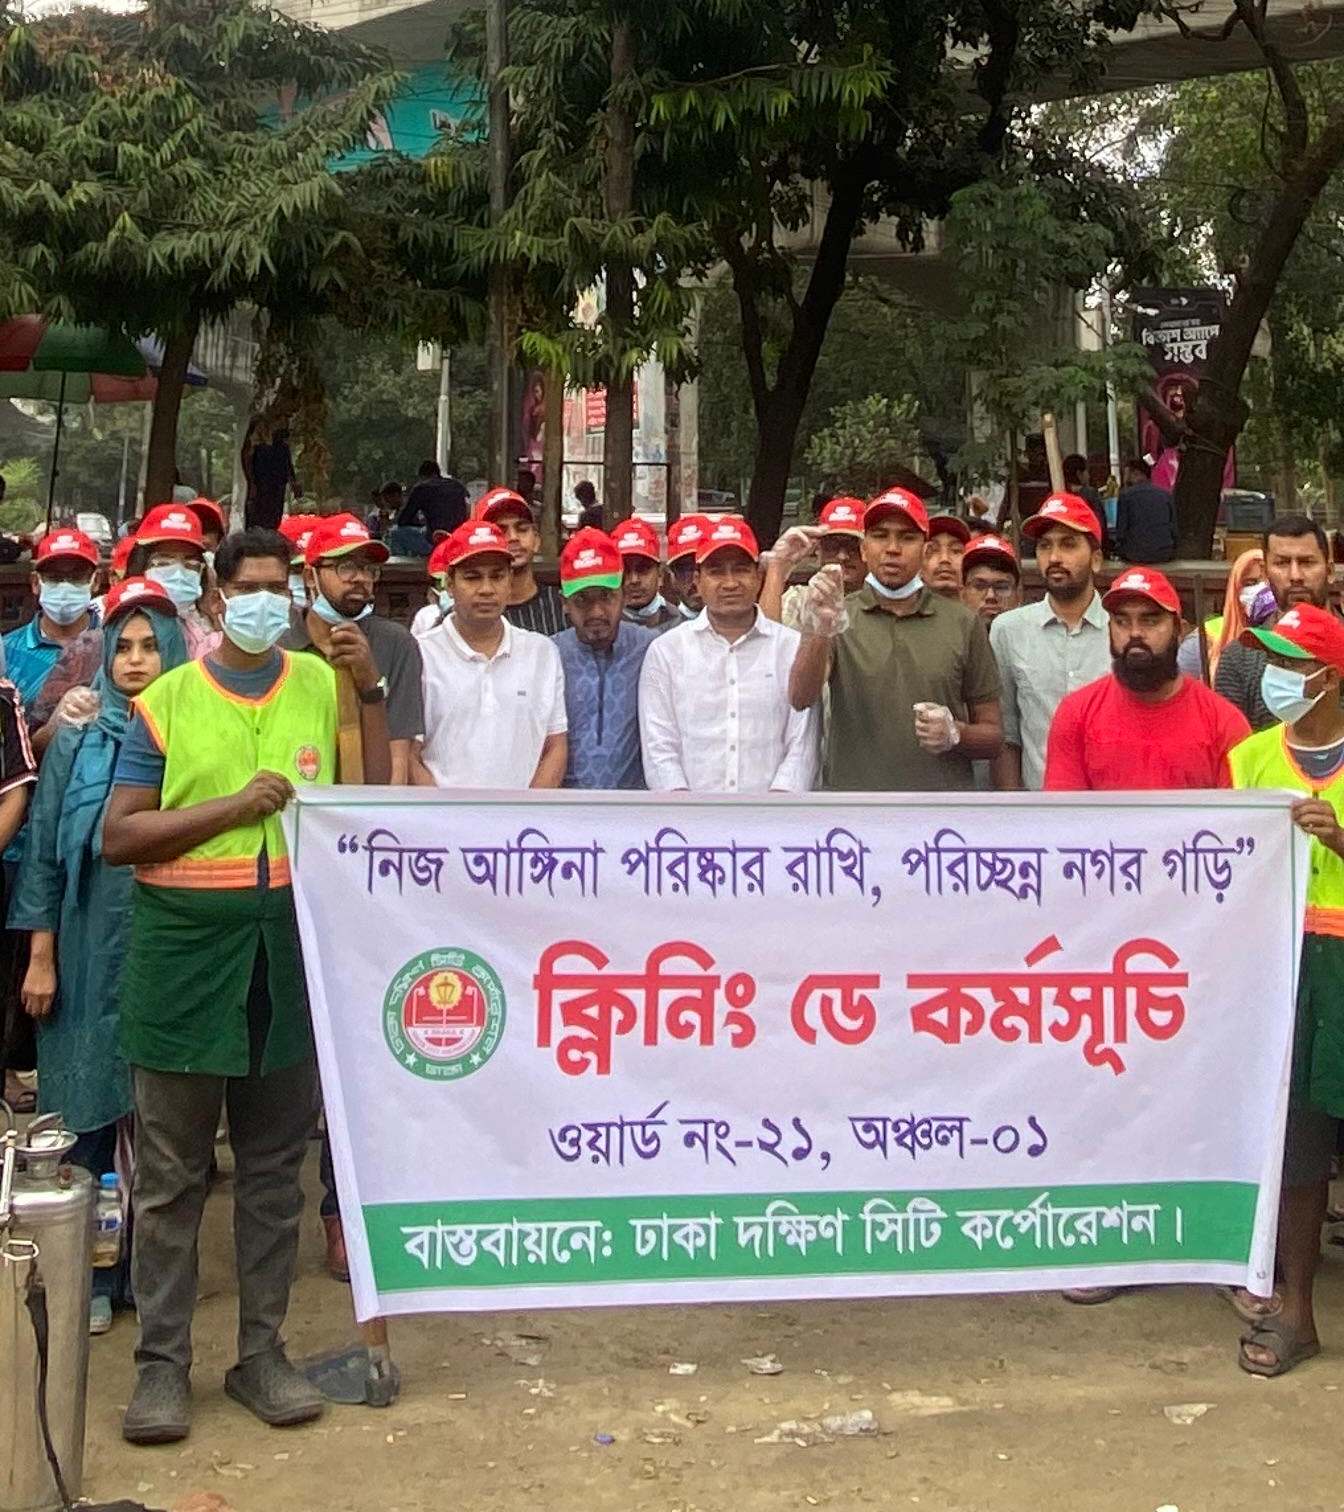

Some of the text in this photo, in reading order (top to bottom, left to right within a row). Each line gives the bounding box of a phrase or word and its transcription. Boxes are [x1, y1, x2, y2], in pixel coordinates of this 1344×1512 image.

[337, 826, 1255, 907] “নিজ আঙ্গিনা পরিষ্কার রাখি, পরিচ্ছন্ন নগর গড়ি”
[533, 934, 1189, 1076] ক্লিনিং ডে কর্মসূচি
[549, 1101, 1049, 1170] ওয়ার্ড নং-২১, অঞ্চল-০১
[628, 1210, 724, 1261] ঢাকা
[733, 1199, 850, 1258] দক্ষিণ
[860, 1197, 948, 1255] সিটি
[955, 1191, 1162, 1251] কর্পোরেশন
